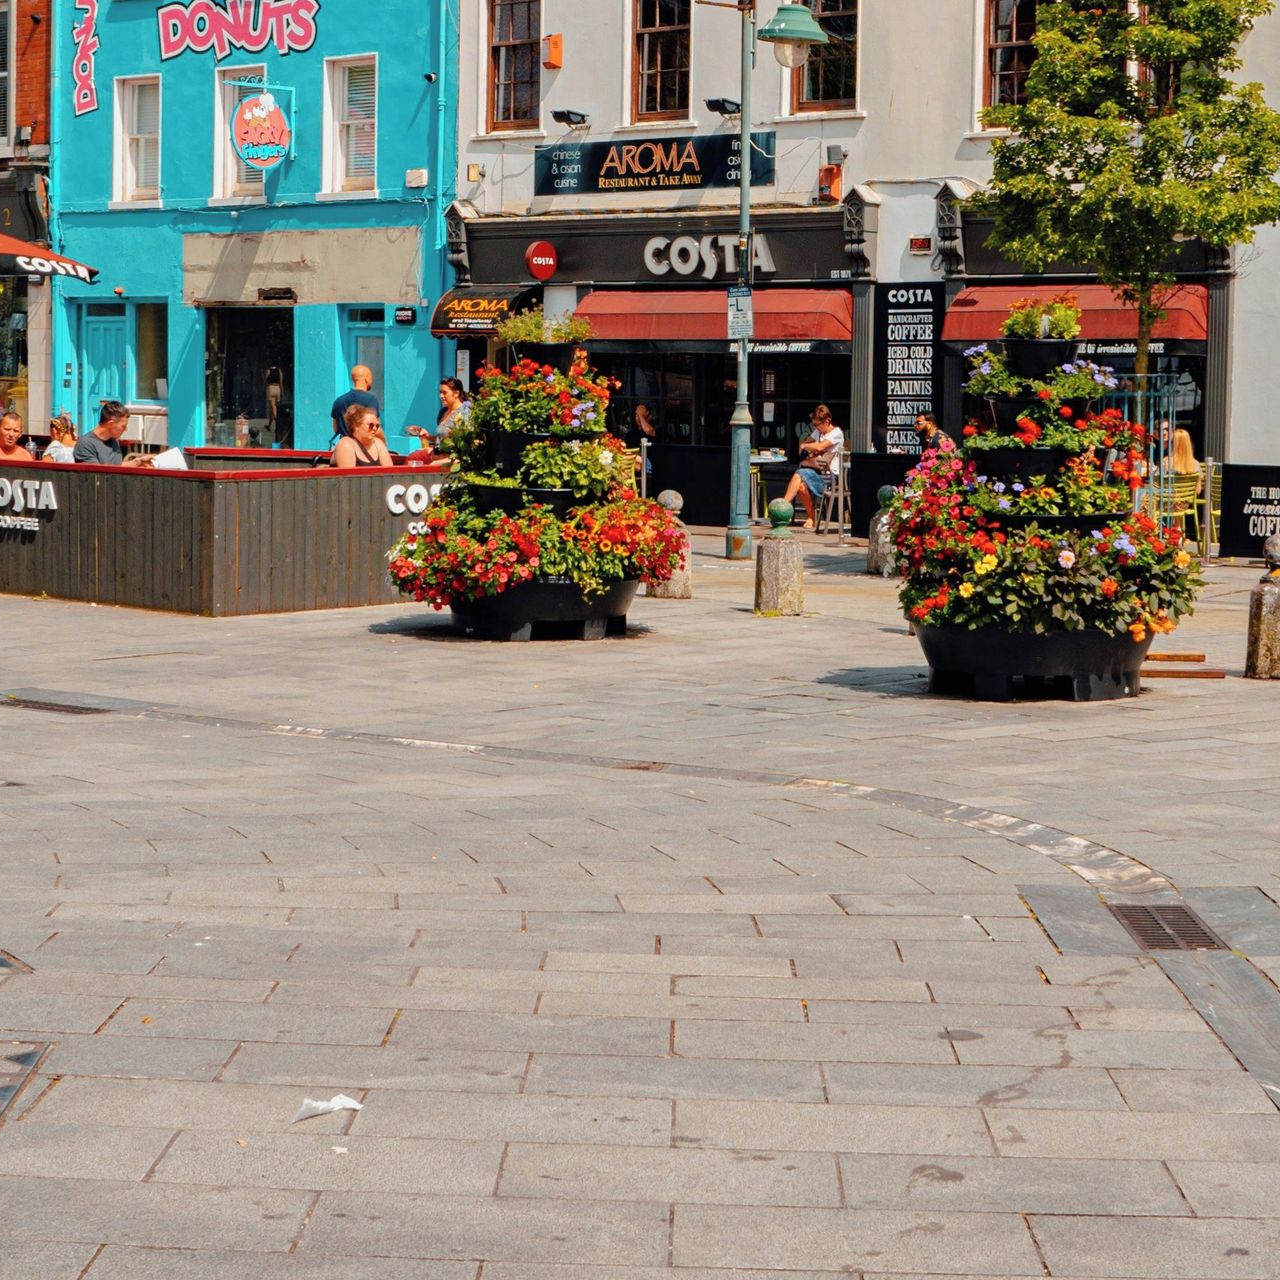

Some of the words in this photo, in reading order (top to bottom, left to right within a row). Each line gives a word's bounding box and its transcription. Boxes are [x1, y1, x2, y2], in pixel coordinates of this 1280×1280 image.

[552, 149, 581, 160] chinese
[600, 141, 700, 176] AROMA
[551, 164, 557, 174] &
[561, 163, 582, 173] asian
[554, 177, 578, 188] cuisine
[598, 175, 650, 189] RESTAURANT
[2, 208, 12, 227] 2
[532, 256, 554, 265] COSTA
[643, 234, 777, 280] COSTA
[16, 256, 90, 283] COSTA
[888, 289, 933, 304] COSTA
[444, 299, 508, 311] AROMA
[447, 311, 499, 319] Restaurant
[888, 315, 933, 324] HANDCRAFTED
[887, 324, 933, 340] COFFEE
[888, 347, 908, 359] ICED
[910, 346, 933, 359] COLD
[887, 359, 933, 375] DRINKS
[887, 381, 933, 395] PANINIS
[887, 401, 932, 415] TOASTED
[886, 431, 920, 444] CAKES
[1251, 487, 1267, 499] THE
